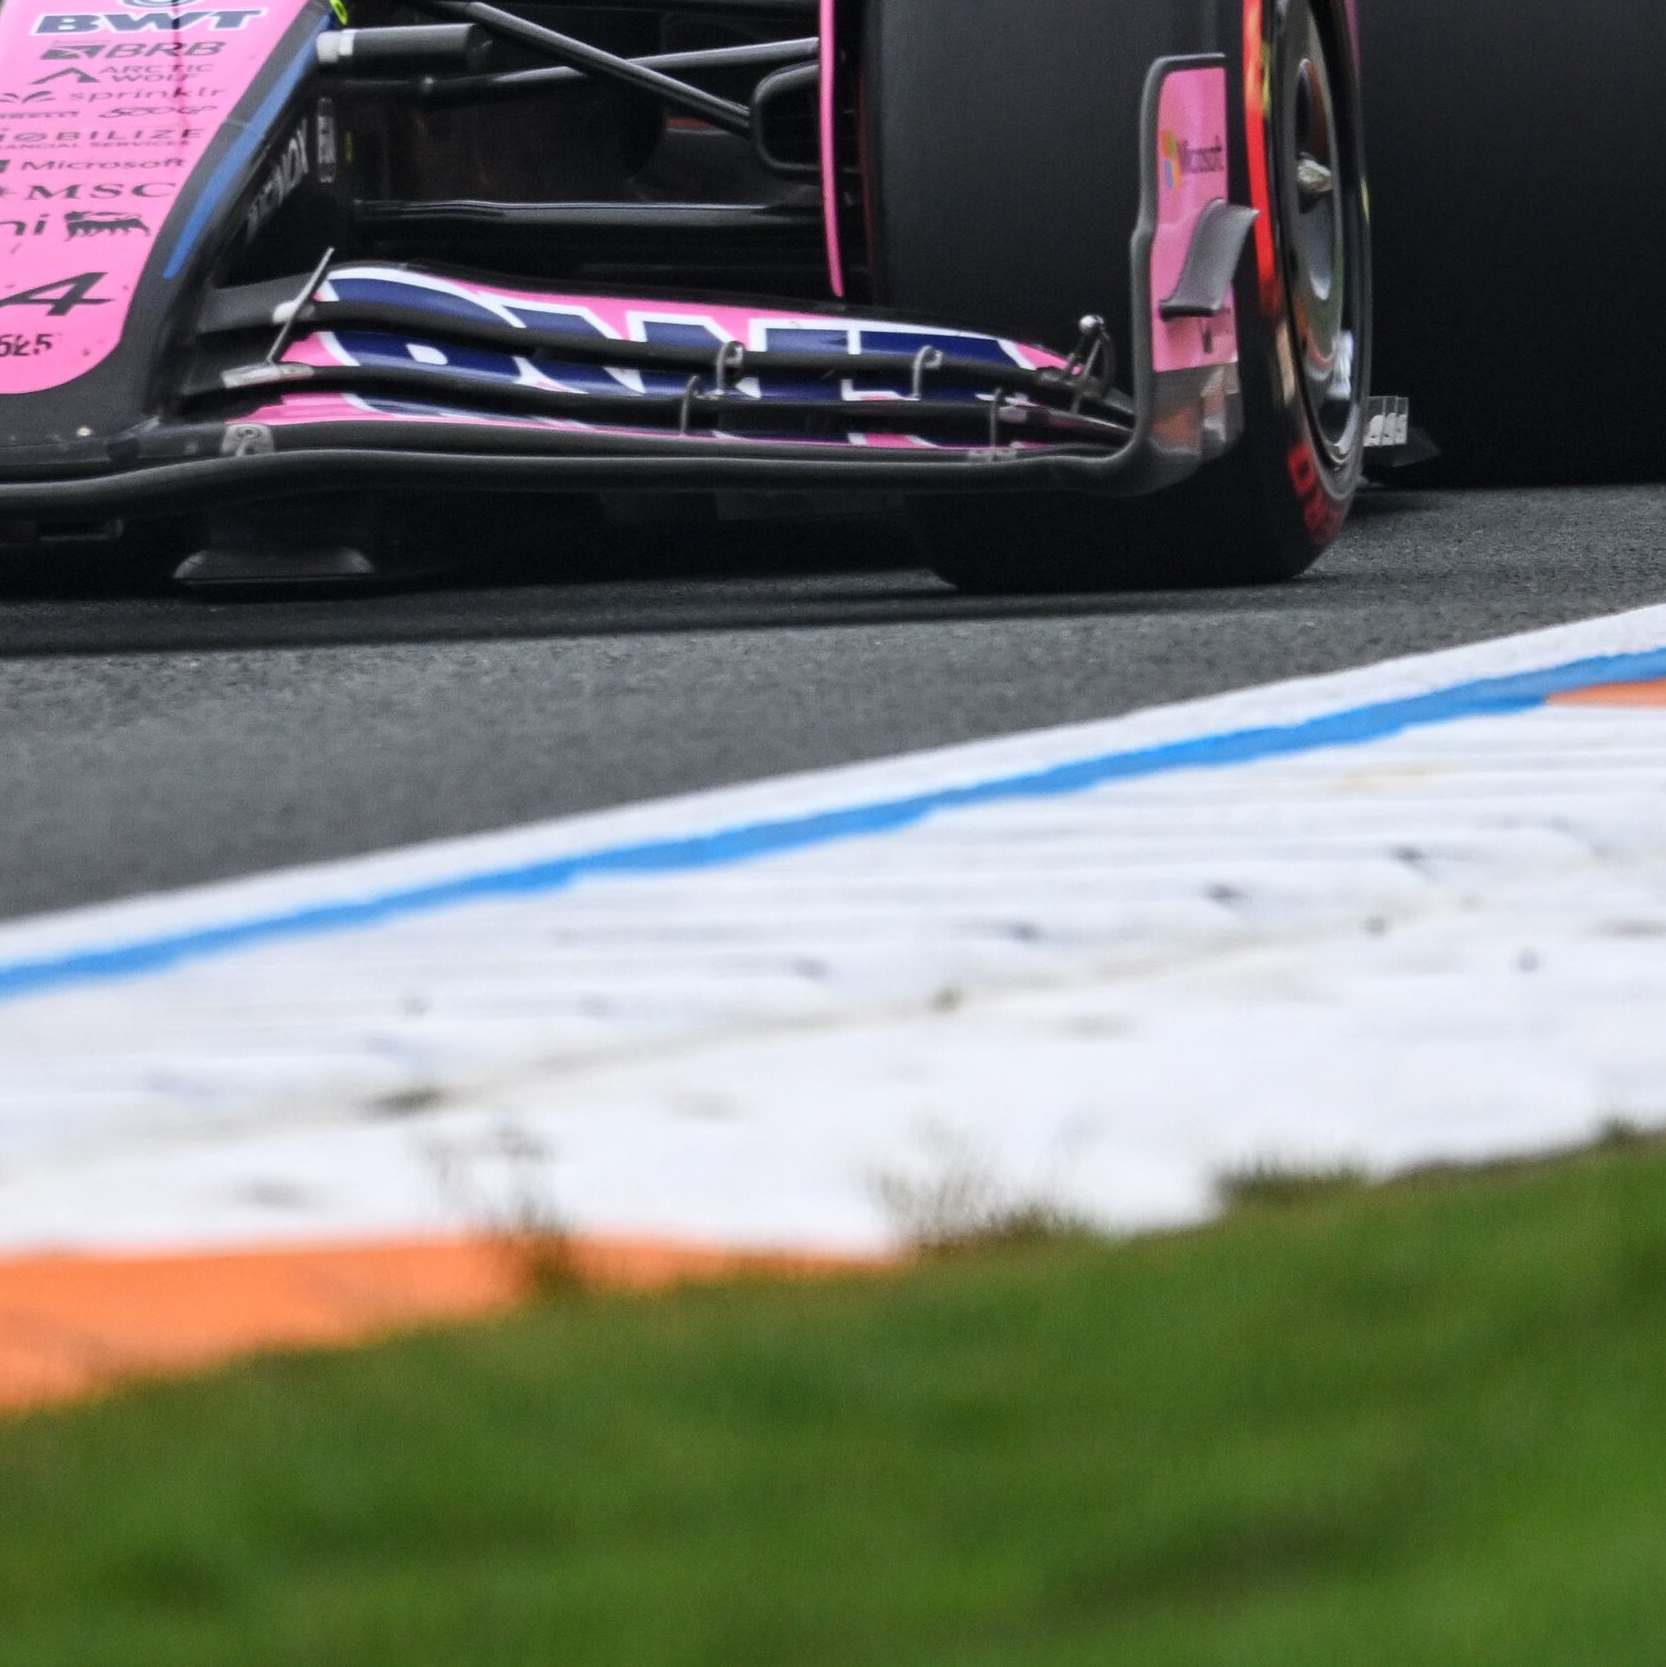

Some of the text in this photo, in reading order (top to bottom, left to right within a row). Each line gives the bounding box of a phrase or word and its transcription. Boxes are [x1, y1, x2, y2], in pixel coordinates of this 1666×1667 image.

[33, 9, 265, 35] BWT
[105, 41, 227, 58] BRB
[99, 64, 215, 73] ARCTIC
[111, 73, 200, 82] WOLF
[20, 158, 186, 171] Microsoft
[25, 183, 176, 200] MSC
